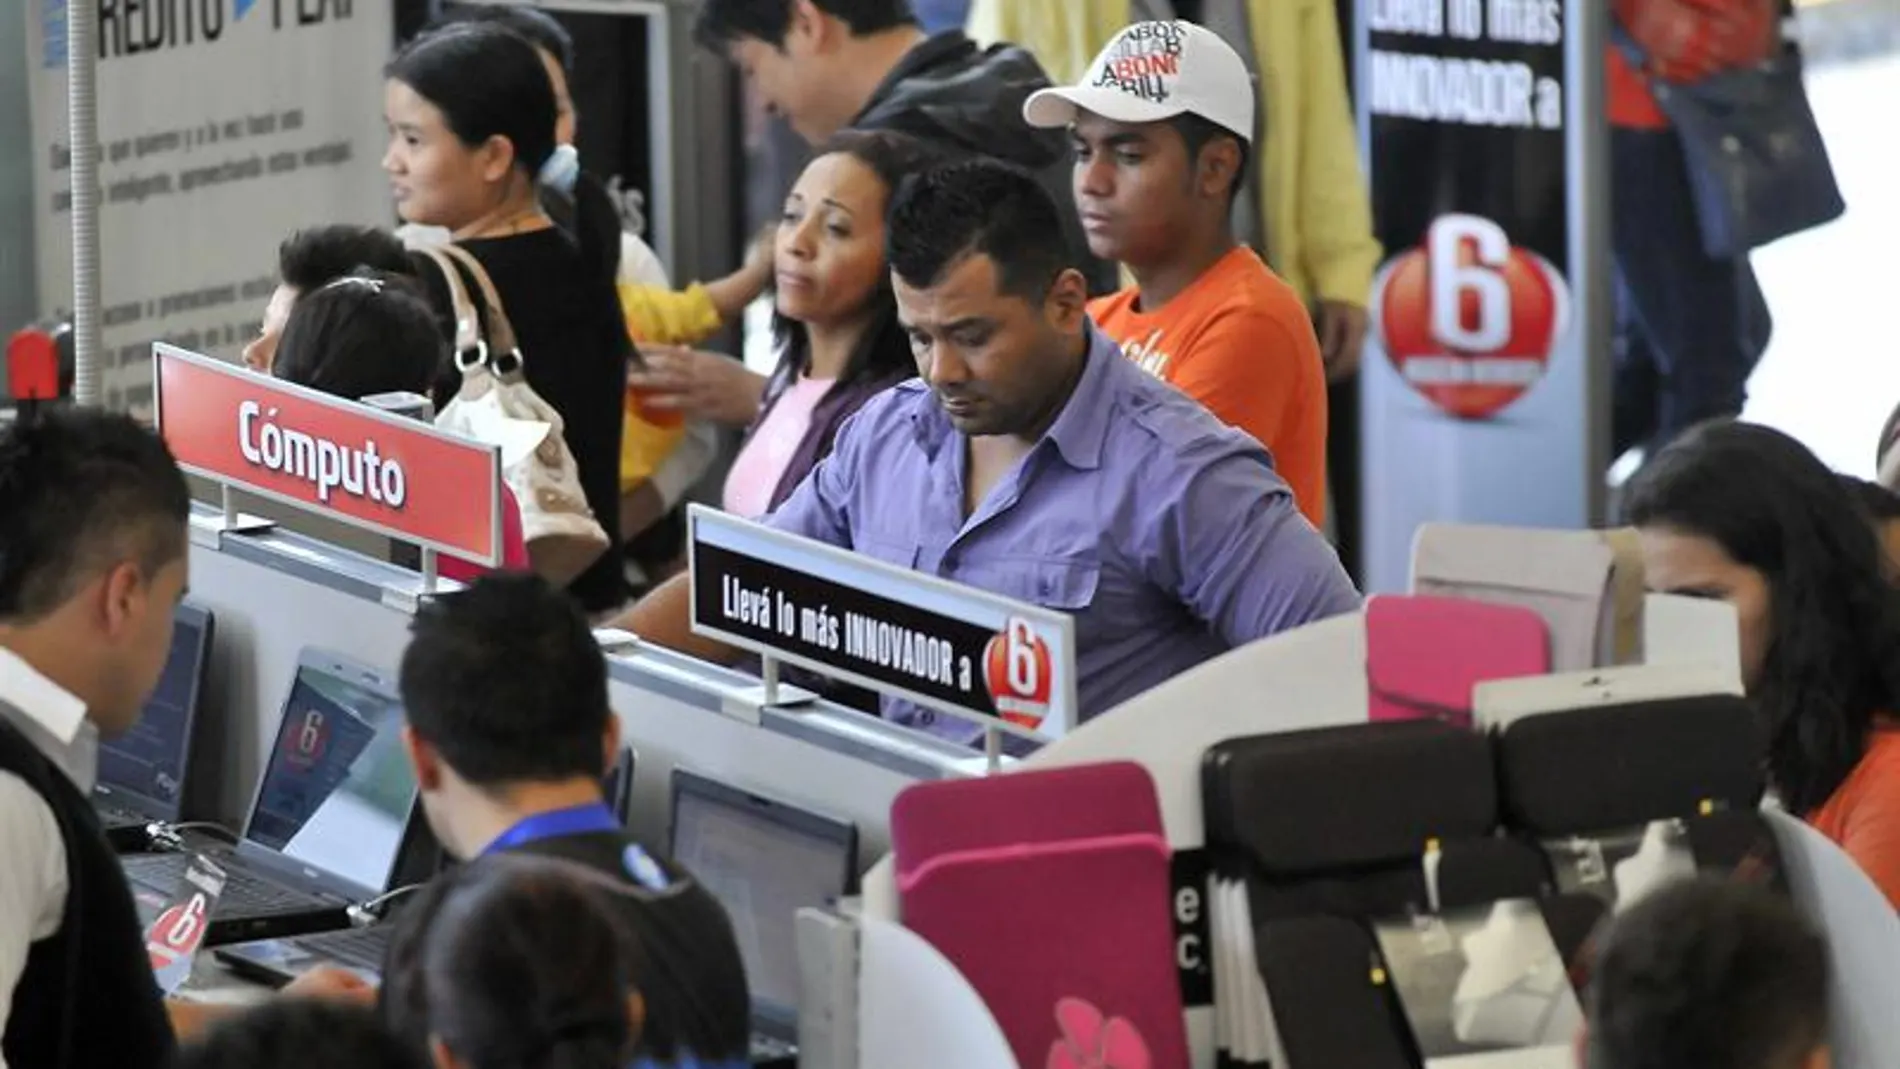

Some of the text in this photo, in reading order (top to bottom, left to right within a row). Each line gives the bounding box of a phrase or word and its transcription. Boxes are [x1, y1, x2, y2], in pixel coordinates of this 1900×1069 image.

[1370, 50, 1562, 130] INNOVADOR a
[1428, 213, 1511, 352] 6
[239, 400, 406, 509] Cómputo
[722, 573, 1038, 698] Llevá lo más INNOVADOR a 6
[300, 709, 324, 754] 6
[168, 892, 206, 945] 6
